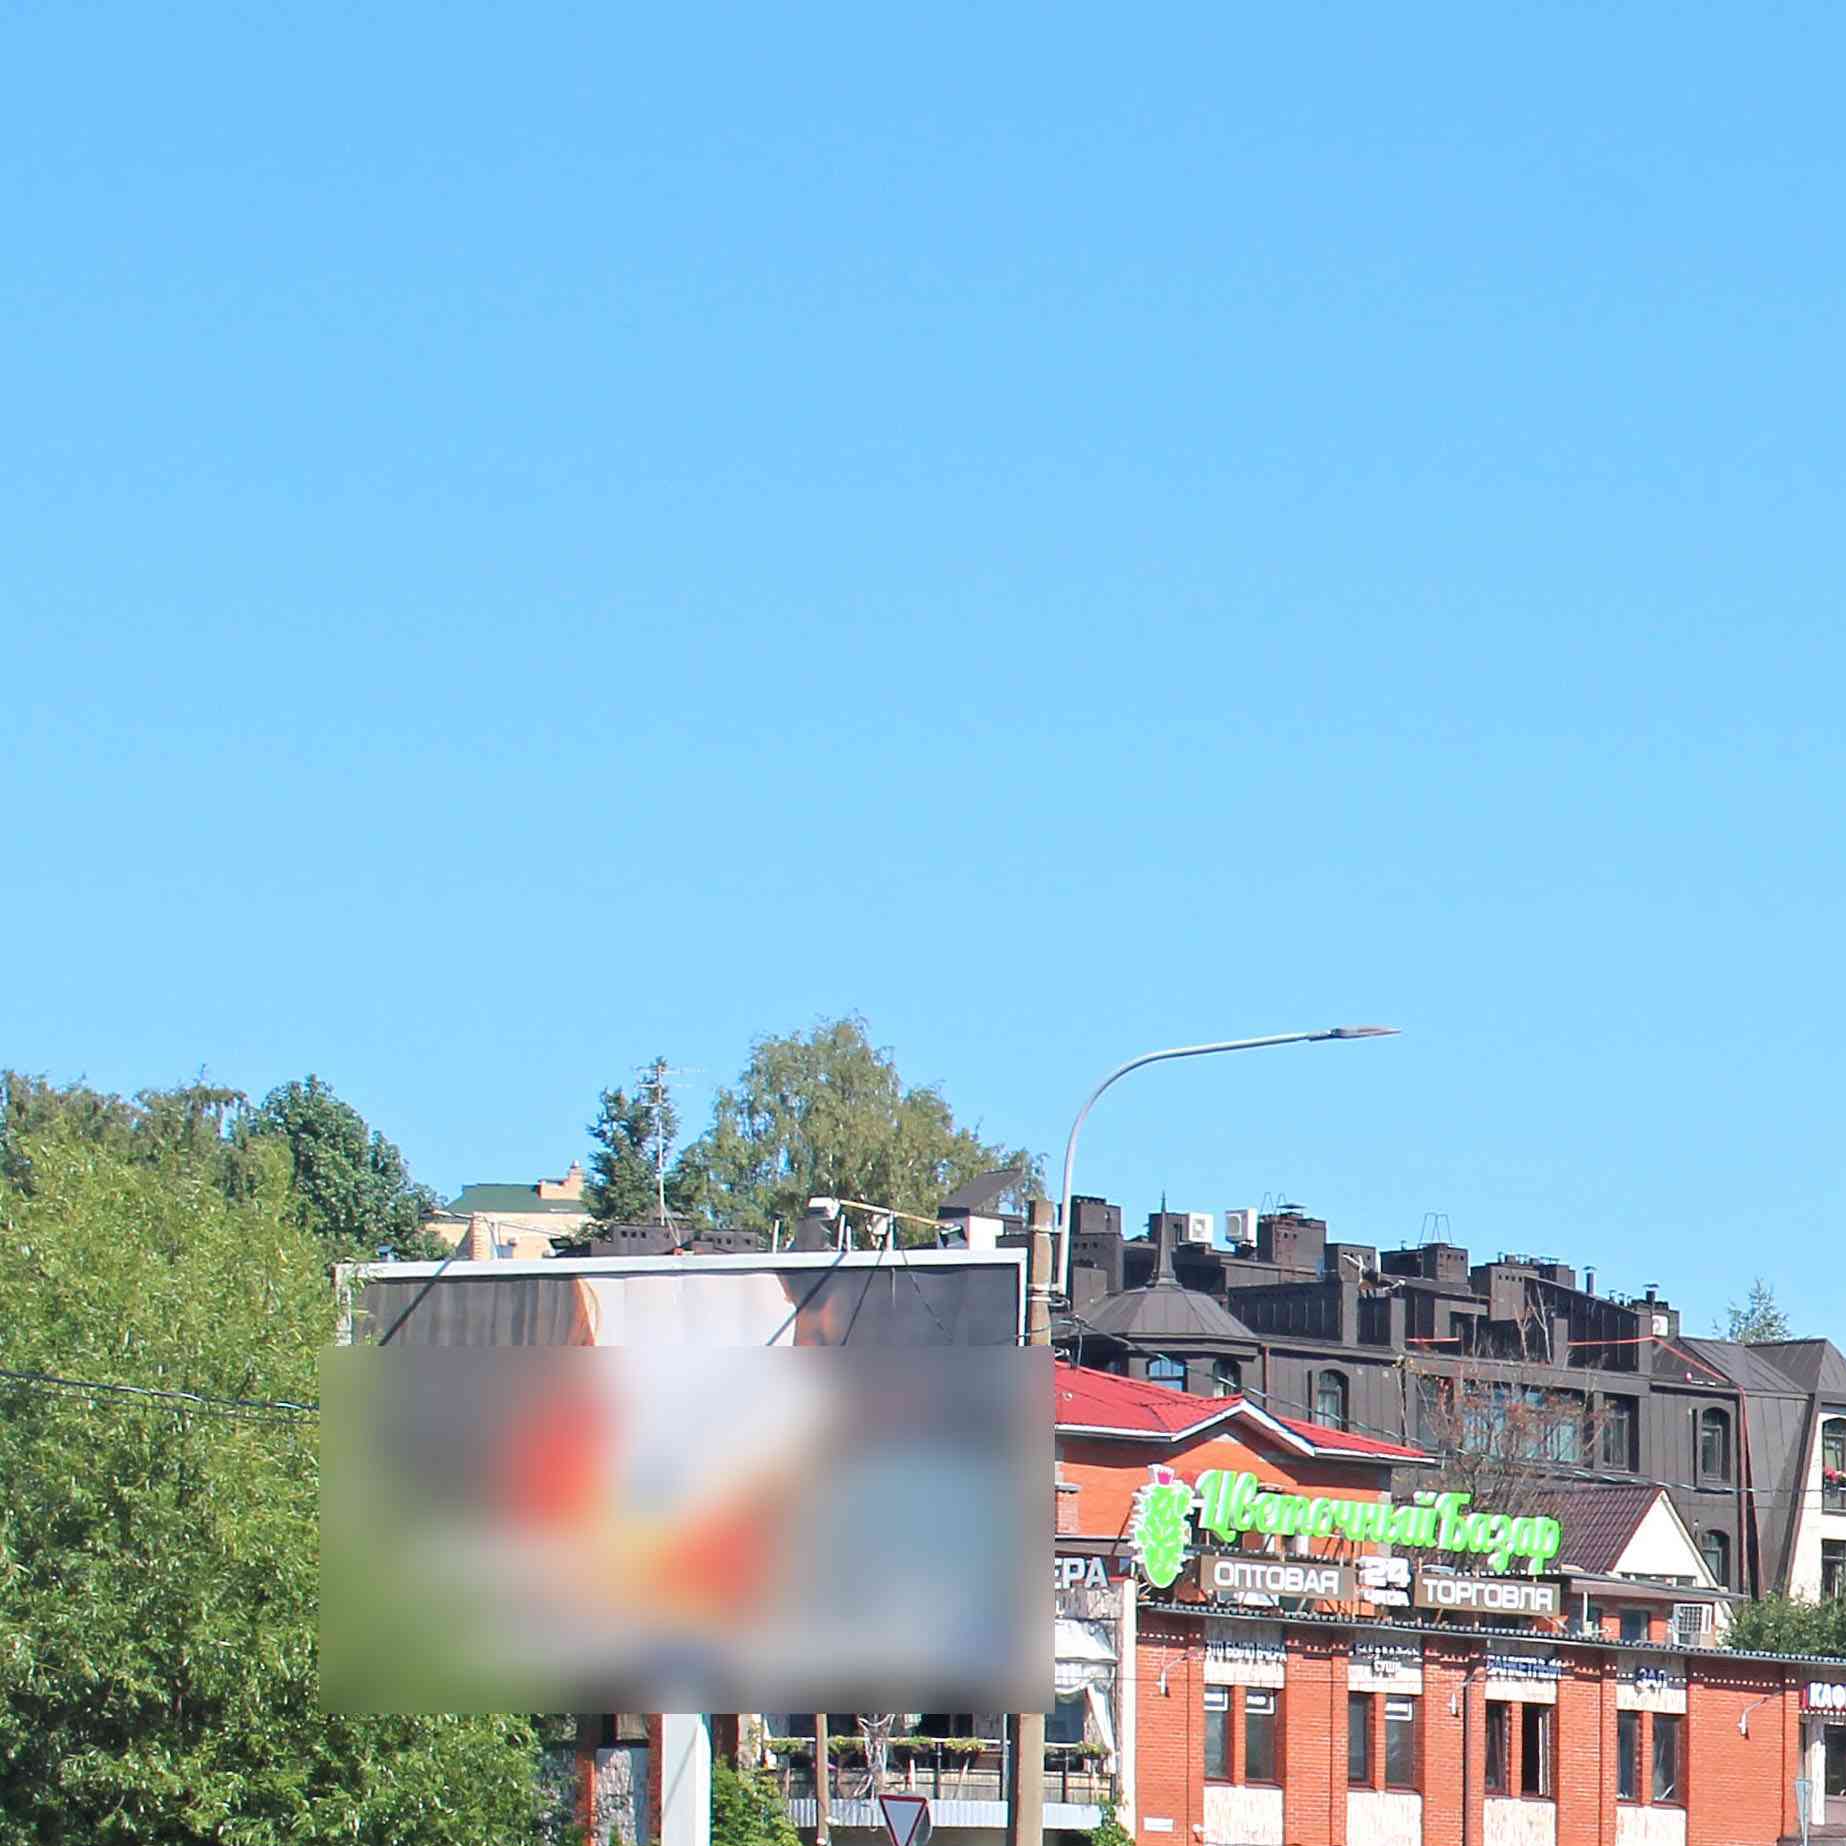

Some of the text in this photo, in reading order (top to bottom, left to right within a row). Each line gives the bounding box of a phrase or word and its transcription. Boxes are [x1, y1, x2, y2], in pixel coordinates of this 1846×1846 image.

[1195, 1469, 1562, 1576] Цветочный Базар
[1213, 1561, 1340, 1595] ОПТОВАЯ
[1359, 1556, 1411, 1588] 24
[1423, 1579, 1553, 1611] ТОРГОВЛЯ
[1636, 1667, 1668, 1688] ЗАЛ
